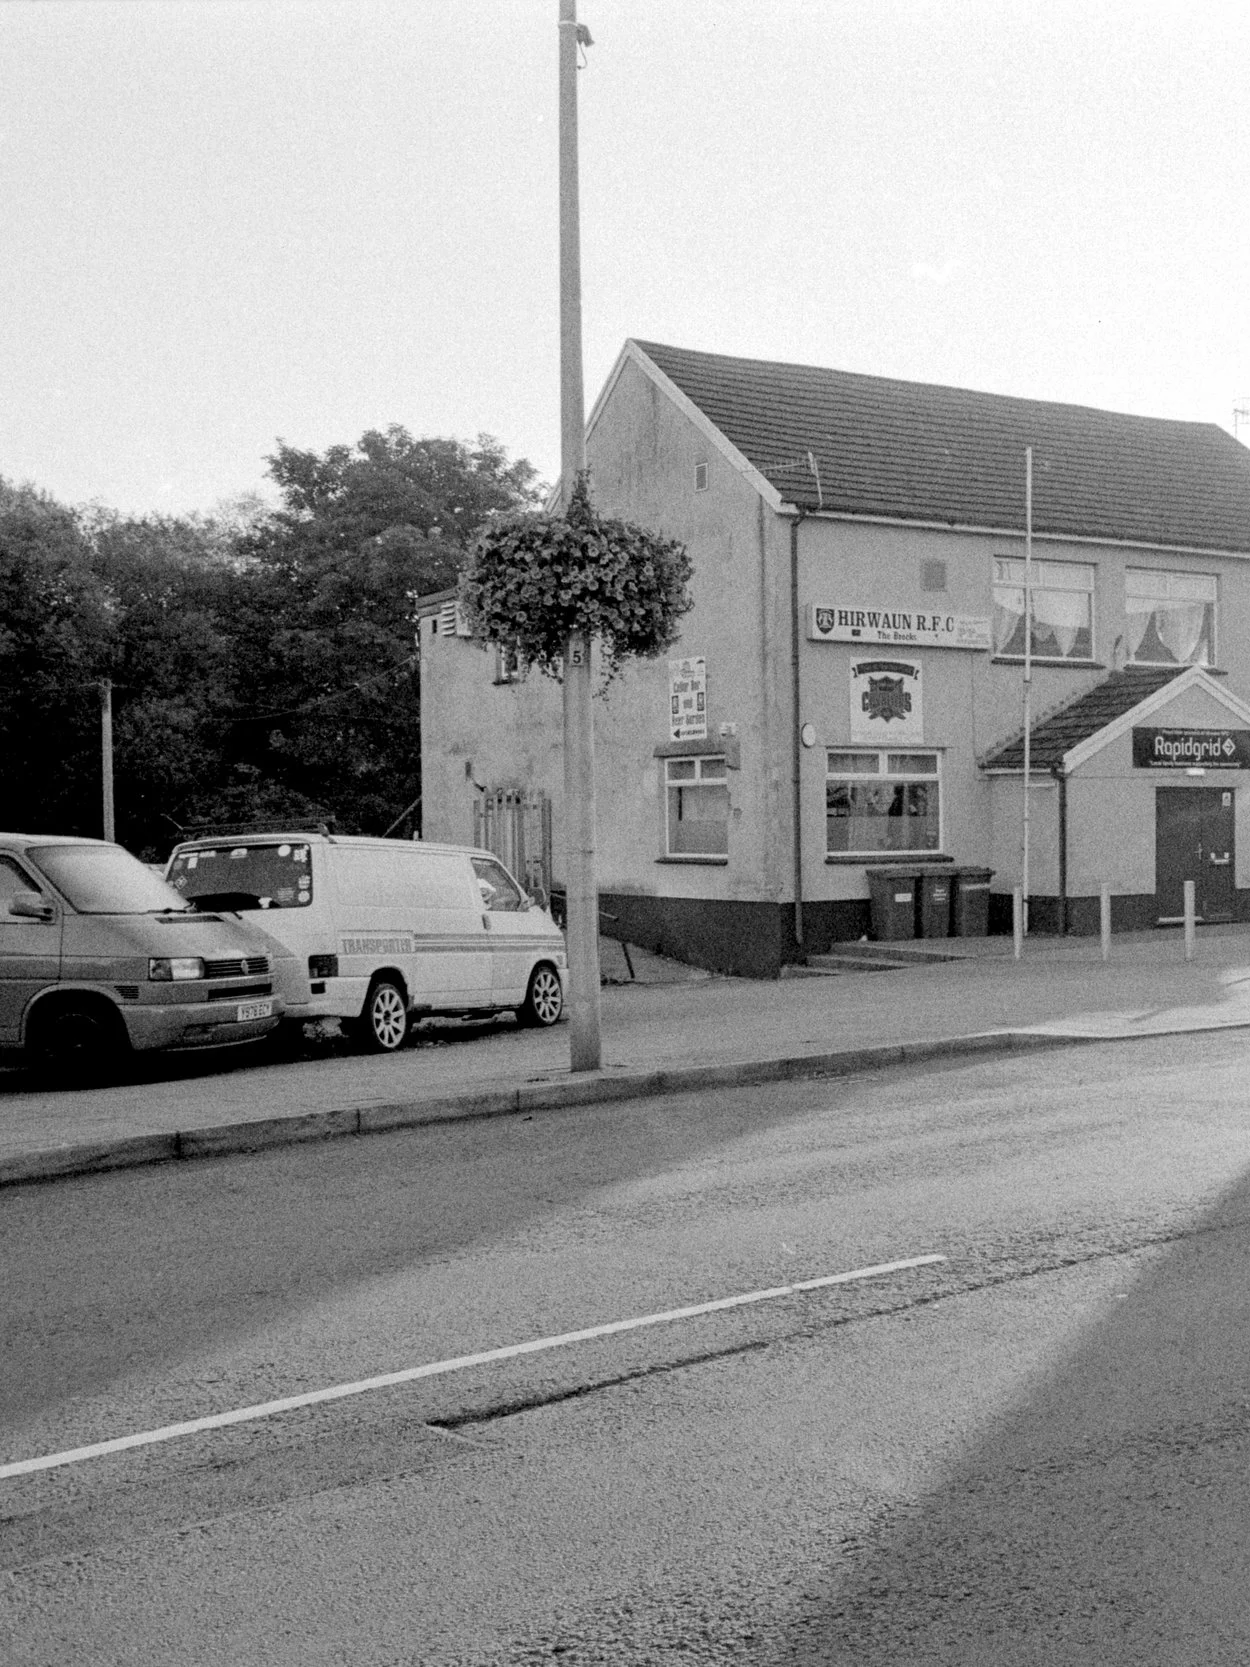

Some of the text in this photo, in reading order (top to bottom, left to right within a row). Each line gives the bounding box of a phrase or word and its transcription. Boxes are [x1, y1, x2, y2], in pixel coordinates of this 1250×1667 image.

[838, 609, 912, 630] HIRWAUN
[916, 614, 955, 633] R.F.C
[877, 630, 891, 641] The
[573, 651, 581, 664] 5
[1154, 735, 1221, 761] Rapidgrid
[341, 938, 412, 955] TRANSPORTER
